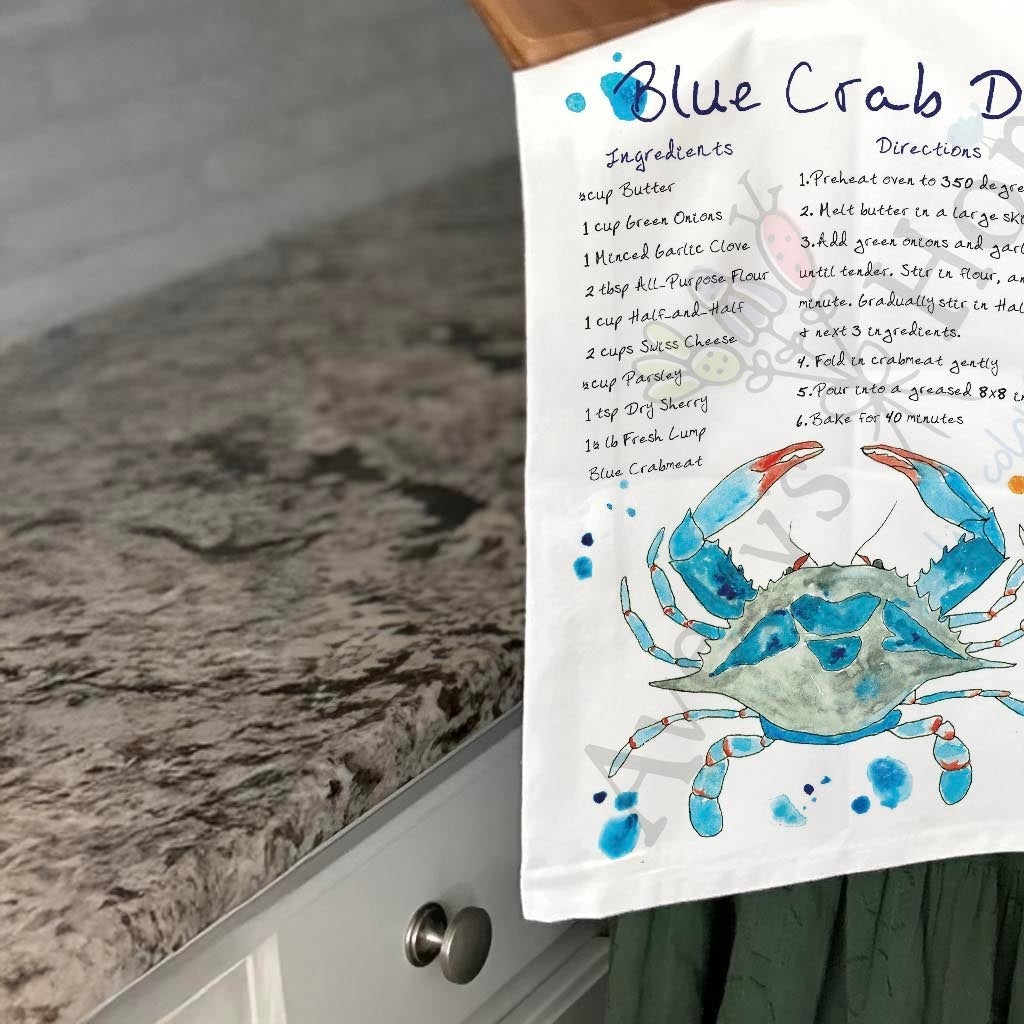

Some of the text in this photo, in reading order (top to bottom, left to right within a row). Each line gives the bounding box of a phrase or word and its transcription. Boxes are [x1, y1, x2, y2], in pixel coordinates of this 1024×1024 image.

[613, 60, 762, 123] Blue
[785, 61, 942, 119] Crab
[605, 138, 734, 173] Ingredients
[875, 136, 982, 159] Directions
[618, 181, 675, 198] Butter
[882, 176, 915, 186] oven
[919, 174, 936, 187] to
[940, 175, 974, 189] 350
[583, 210, 723, 237] 1 cup Green Onions
[799, 205, 814, 217] 2.
[819, 202, 855, 218] Melt
[860, 202, 909, 216] butter
[915, 207, 930, 218] in
[935, 208, 948, 218] a
[952, 206, 999, 229] large
[584, 239, 751, 268] 1 Minced Garlic Clove
[853, 238, 897, 255] green
[902, 237, 949, 249] onions
[954, 234, 983, 250] and
[584, 285, 595, 298] 2
[599, 280, 630, 299] tbsp
[731, 268, 769, 284] Flour
[798, 265, 835, 279] until
[839, 260, 894, 277] tender.
[900, 263, 932, 278] Stir
[938, 268, 953, 279] in
[960, 267, 1001, 285] flour,
[798, 295, 852, 310] minute.
[858, 290, 935, 315] Gradually
[938, 297, 968, 310] stir
[973, 299, 989, 311] in
[584, 315, 591, 330] 1
[596, 315, 623, 331] cup
[815, 325, 847, 338] next
[851, 325, 862, 337] 3
[867, 320, 961, 344] ingredients.
[585, 333, 738, 362] 2 cups Swiss Cheese
[797, 350, 999, 377] 4. Fold in crabmeat gently
[621, 369, 682, 387] Parsley
[855, 383, 886, 396] into
[890, 385, 902, 394] a
[908, 381, 972, 402] greased
[585, 395, 708, 423] 1 tsp Dry Sherry
[858, 412, 881, 423] for
[885, 410, 903, 424] 40
[907, 413, 964, 425] minutes
[605, 434, 619, 449] lb
[623, 428, 664, 447] Fresh
[668, 425, 707, 443] Lump
[589, 455, 703, 481] Blue Crabmeat
